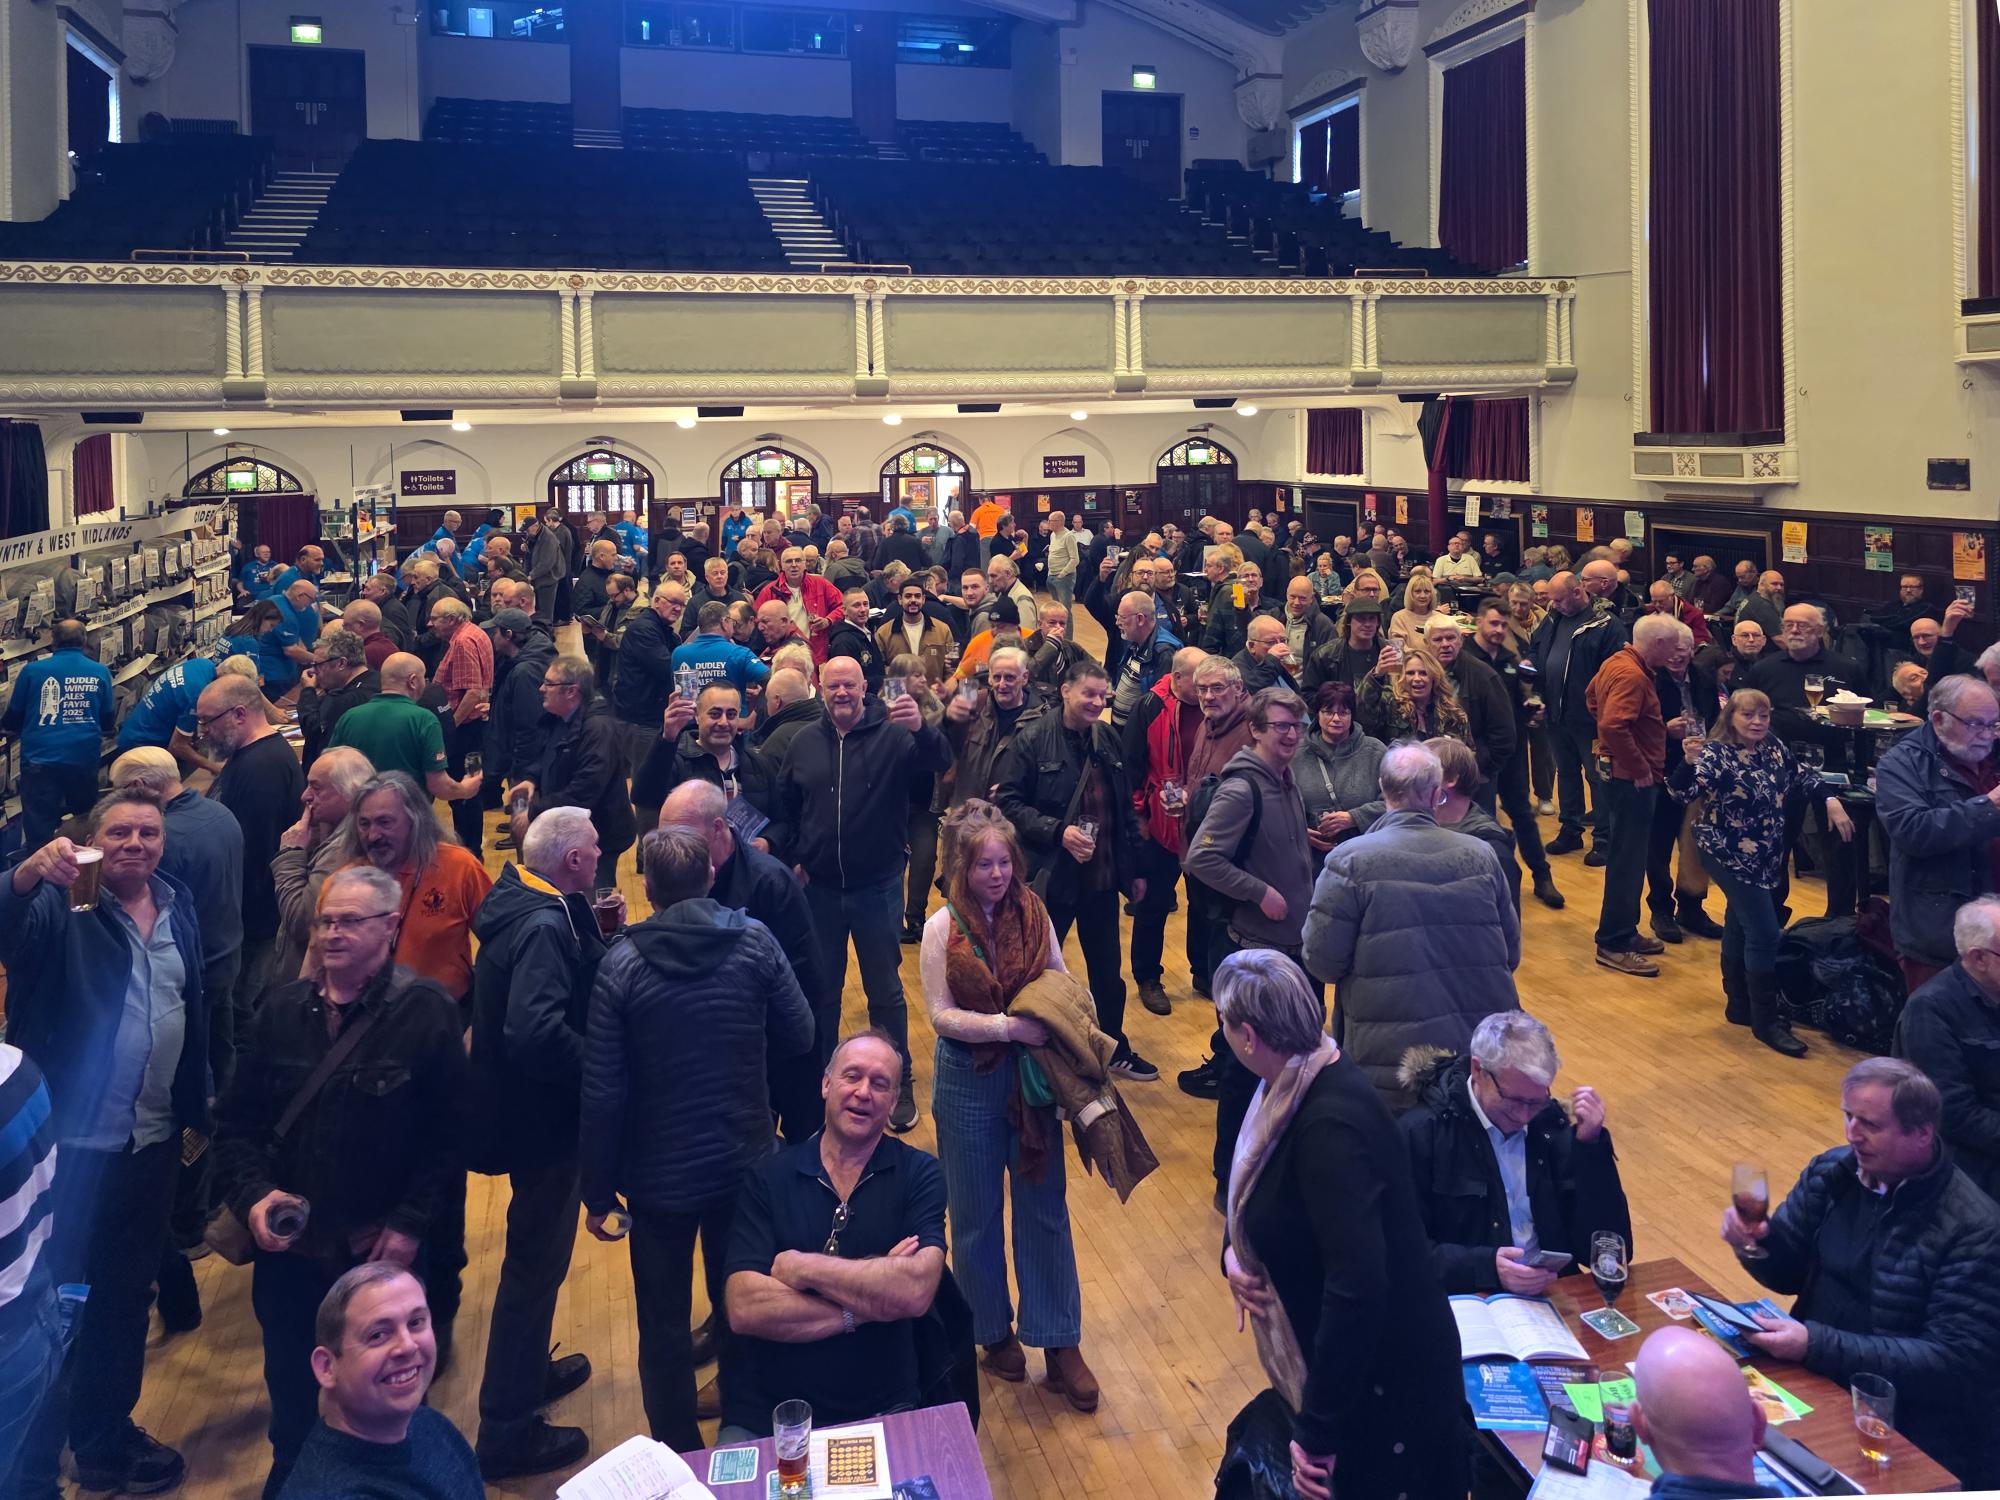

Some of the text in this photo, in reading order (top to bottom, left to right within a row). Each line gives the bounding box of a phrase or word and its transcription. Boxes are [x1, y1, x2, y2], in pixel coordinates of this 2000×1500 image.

[417, 483, 444, 491] Toilets
[37, 538, 44, 555] &
[49, 531, 76, 552] WEST
[82, 526, 133, 545] MIDLANDS
[695, 661, 727, 669] DUDLEY
[64, 677, 99, 685] DUDLEY
[64, 684, 98, 692] WINTER
[64, 692, 85, 700] ALES
[62, 700, 91, 708] FAYRE
